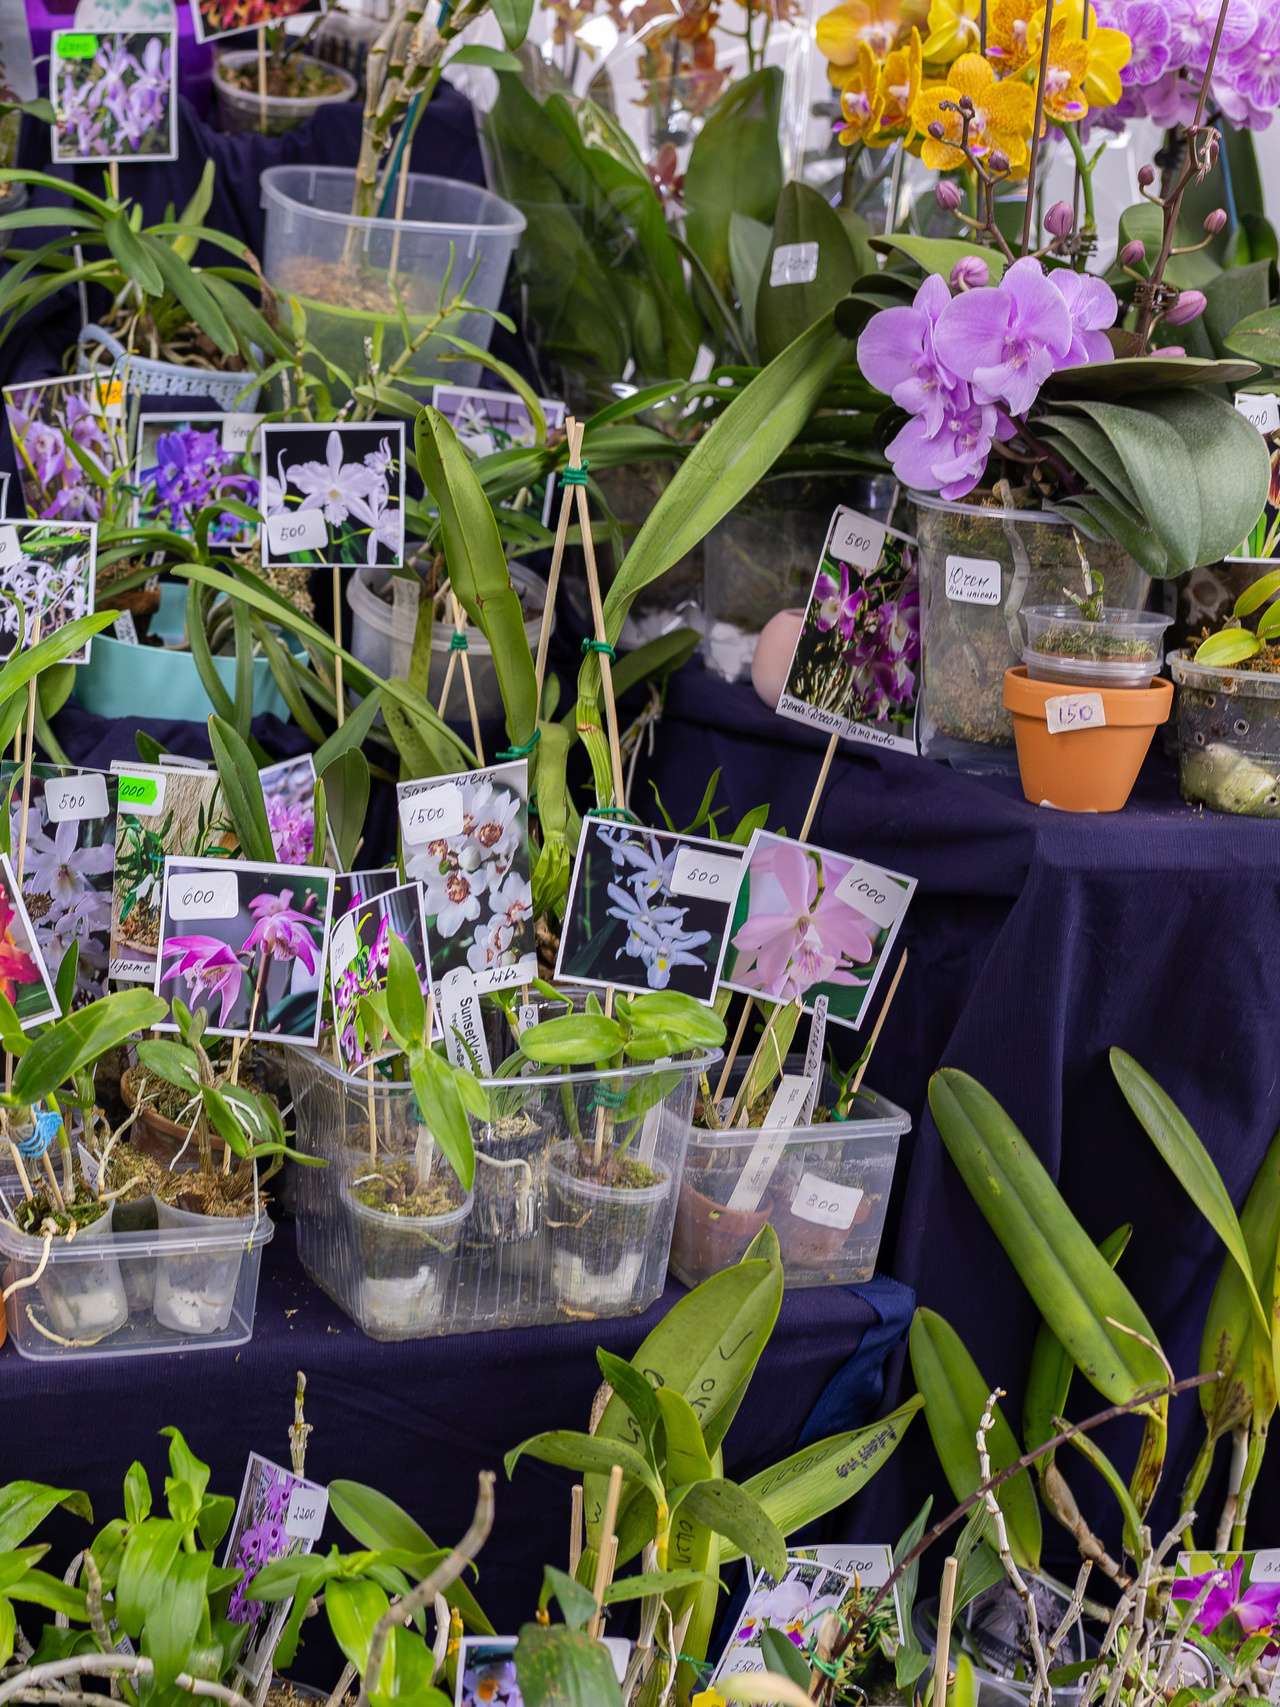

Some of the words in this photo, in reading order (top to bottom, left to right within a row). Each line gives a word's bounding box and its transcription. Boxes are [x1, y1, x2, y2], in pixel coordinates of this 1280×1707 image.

[280, 524, 306, 541] 500
[845, 532, 871, 551] 500
[1059, 702, 1093, 724] 150
[844, 719, 893, 746] Yamamoto
[58, 794, 85, 810] 500
[409, 807, 444, 826] 1500
[182, 887, 214, 906] 600
[850, 878, 886, 904] 1000
[460, 996, 486, 1075] SunsetVall
[293, 1505, 316, 1521] 2200
